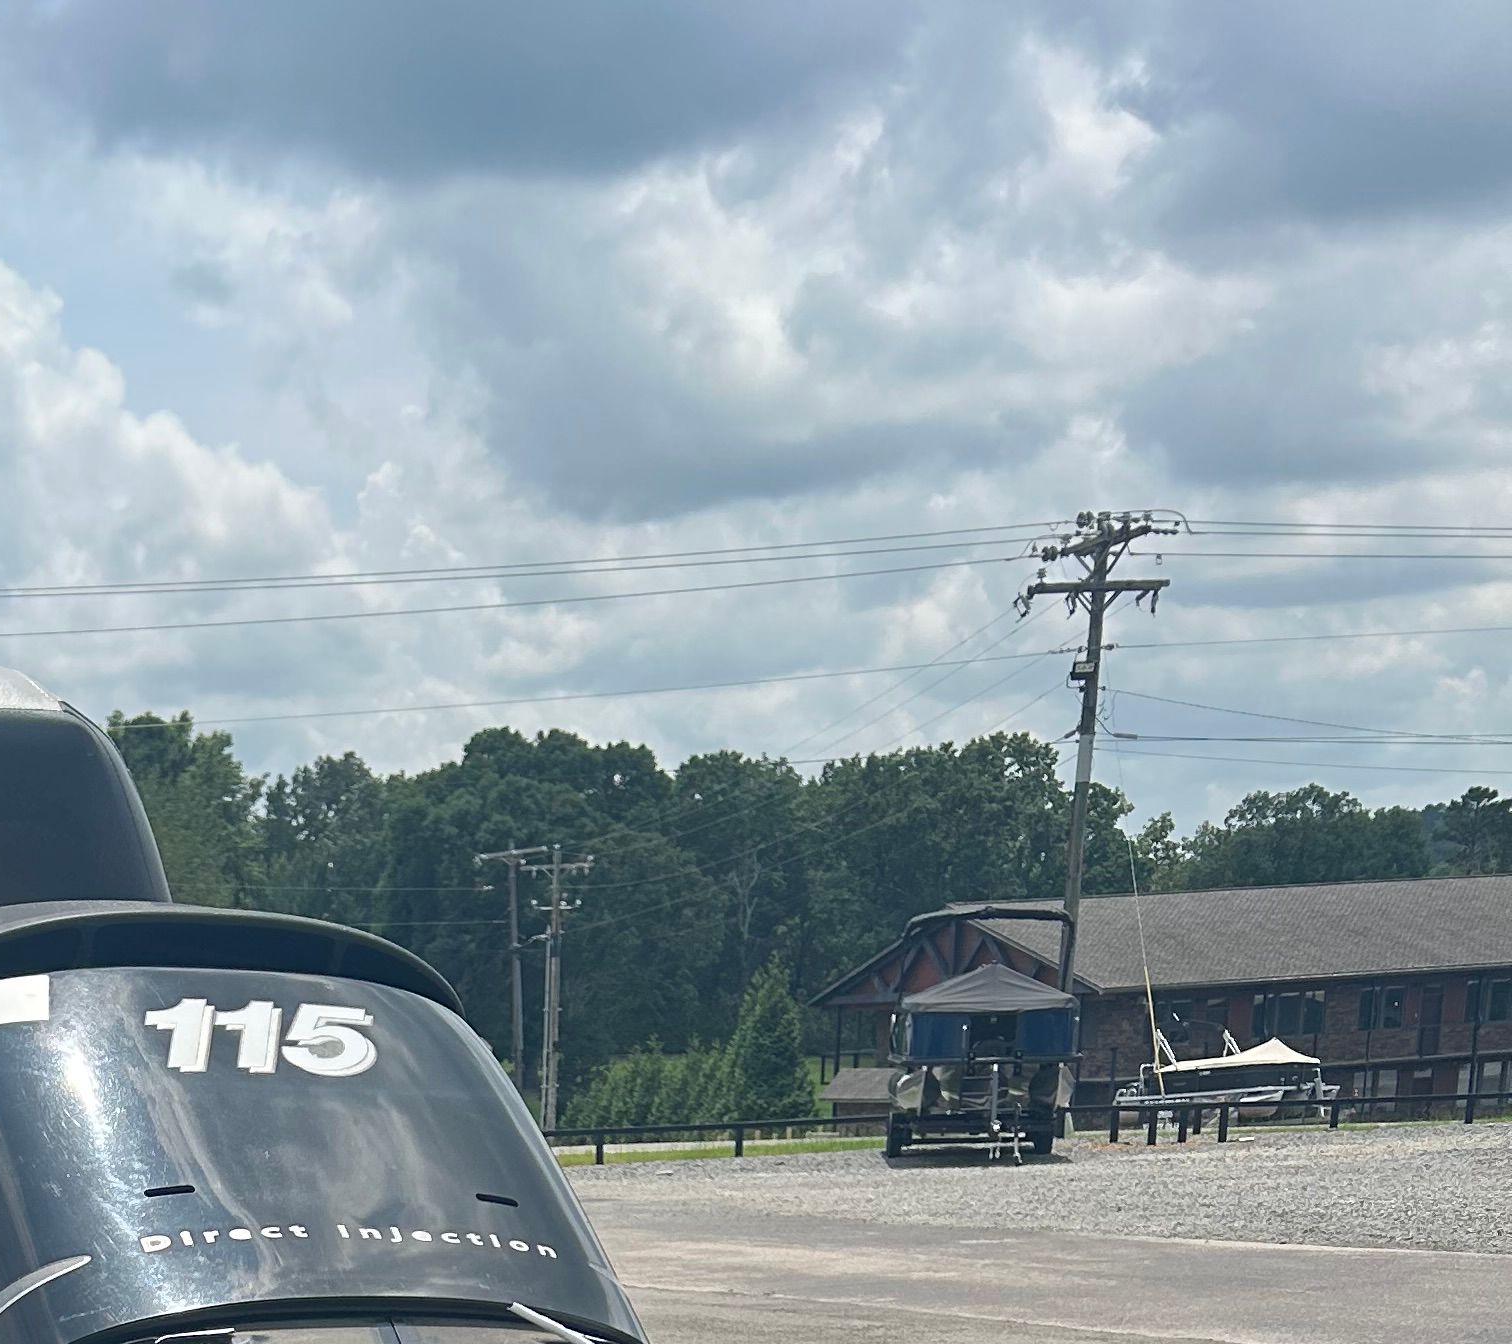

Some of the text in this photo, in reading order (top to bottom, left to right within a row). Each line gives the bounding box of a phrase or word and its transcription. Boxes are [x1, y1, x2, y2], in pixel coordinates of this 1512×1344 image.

[144, 997, 379, 1078] 115
[139, 1223, 558, 1260] Direct Injection
